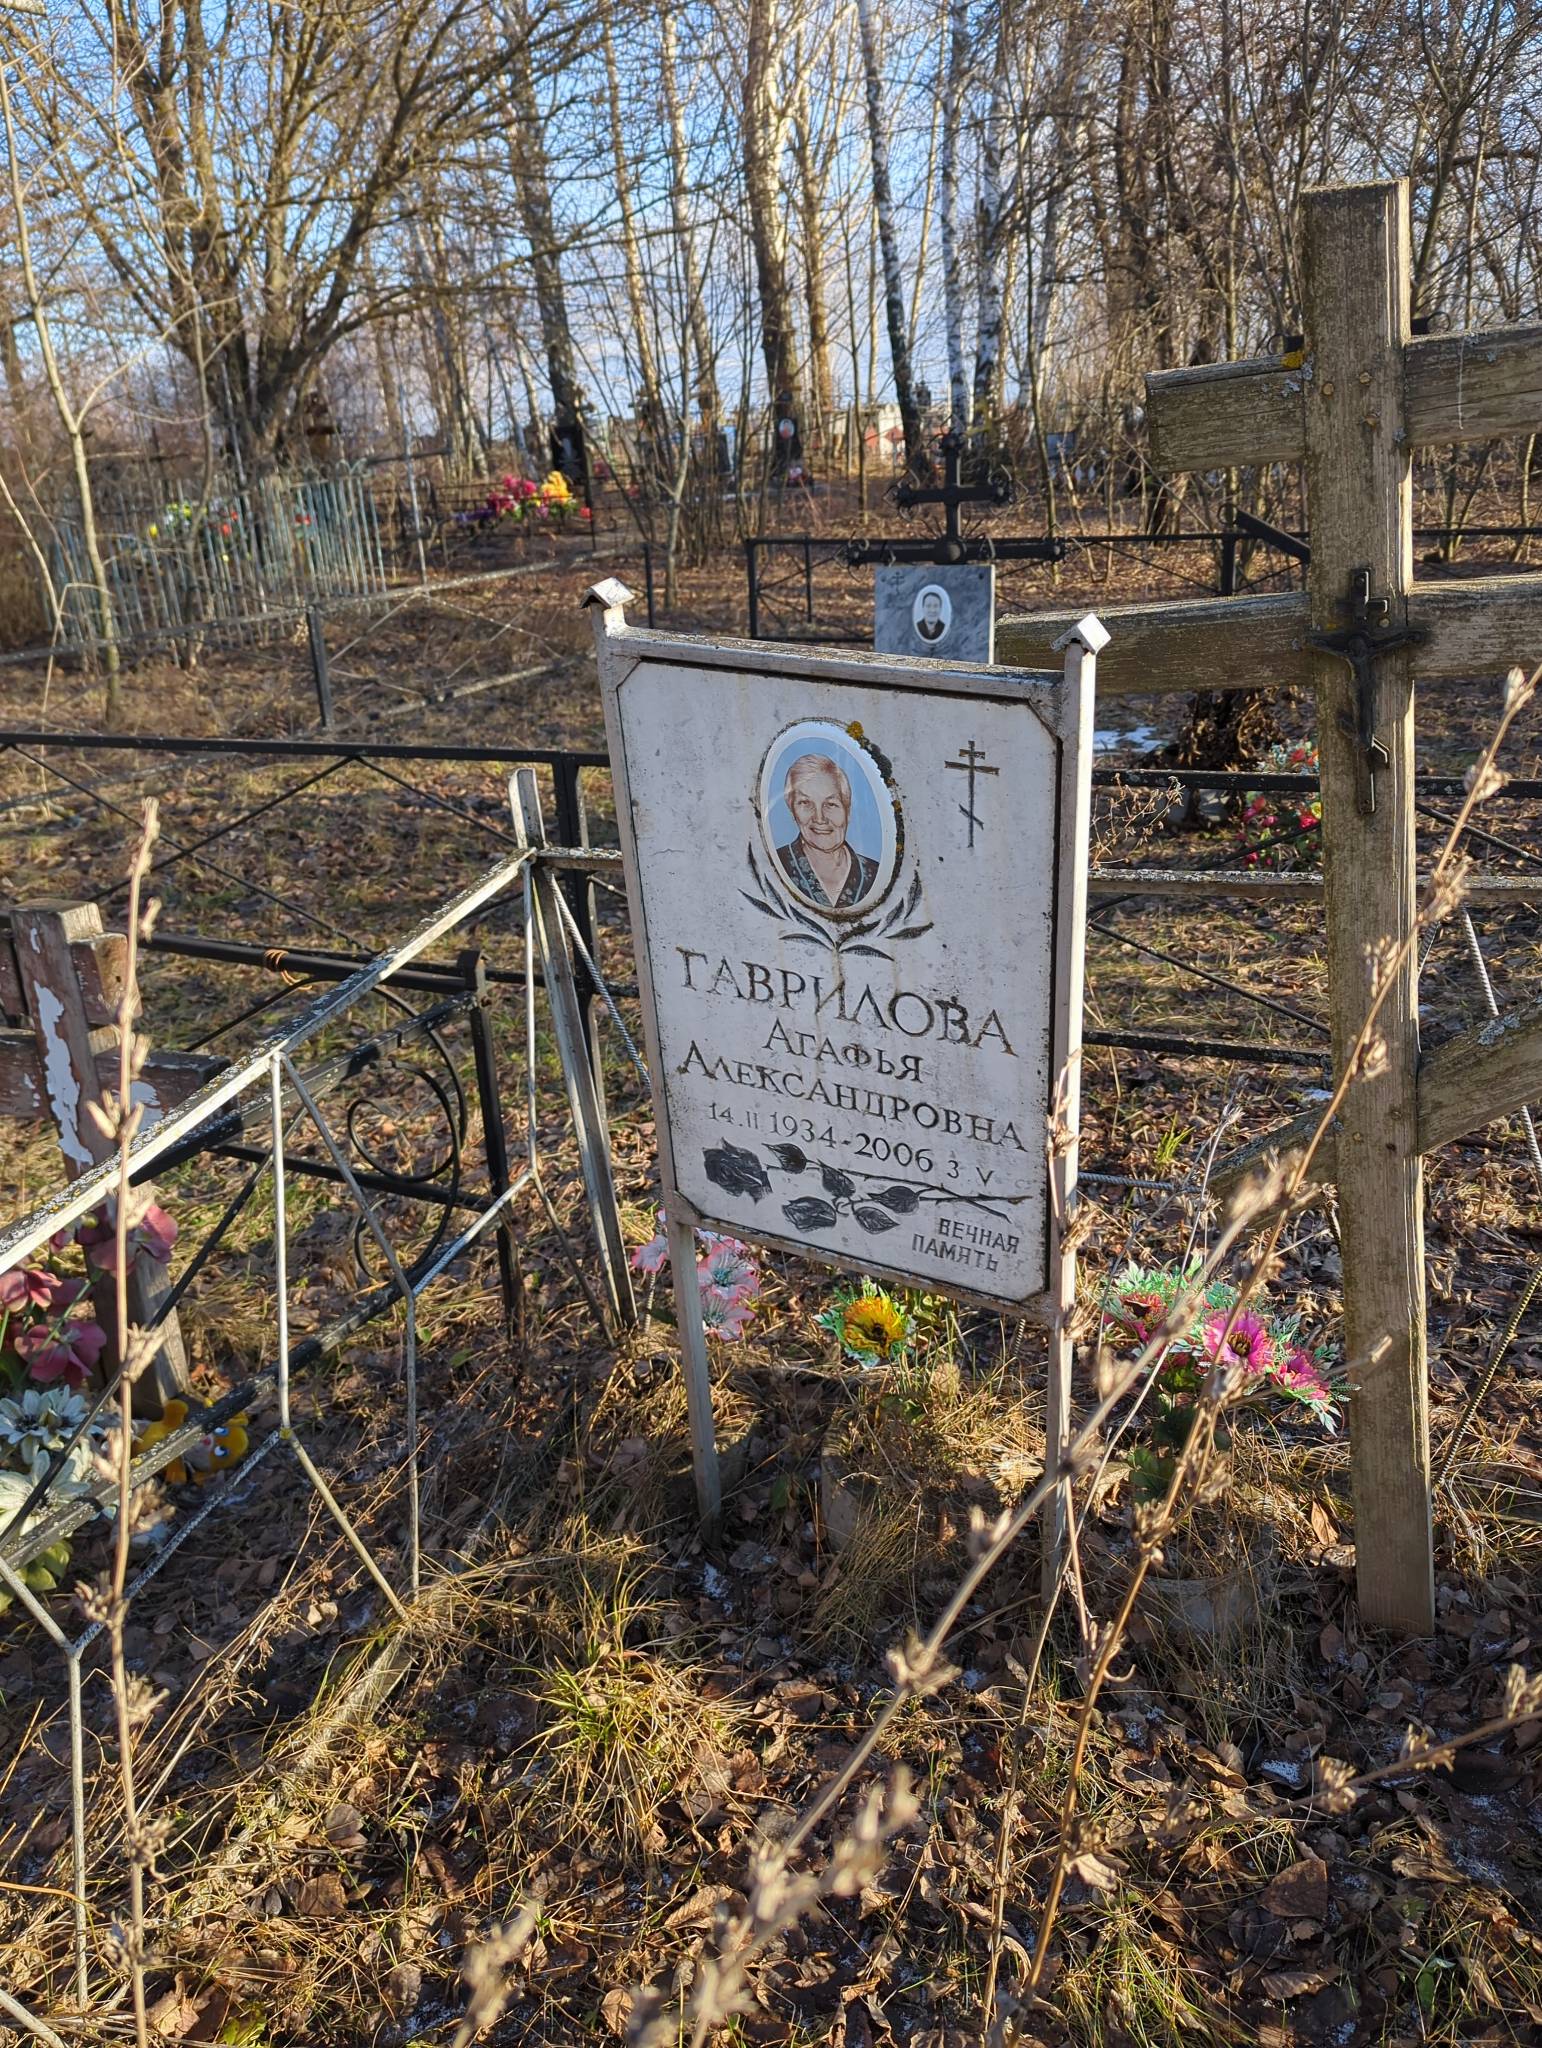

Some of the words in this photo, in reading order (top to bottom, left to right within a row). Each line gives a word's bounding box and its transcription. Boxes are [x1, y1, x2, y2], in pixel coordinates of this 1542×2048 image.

[675, 946, 1019, 1057] ГАВРИЛОВА
[761, 1017, 925, 1084] АГАФЬЯ
[676, 1040, 1028, 1152] АЛЕКСАНДРОВНА
[946, 1159, 961, 1179] 3
[912, 1233, 1000, 1273] ПАМЯТЬ
[938, 1217, 1020, 1254] ВЕЧНАЯ
